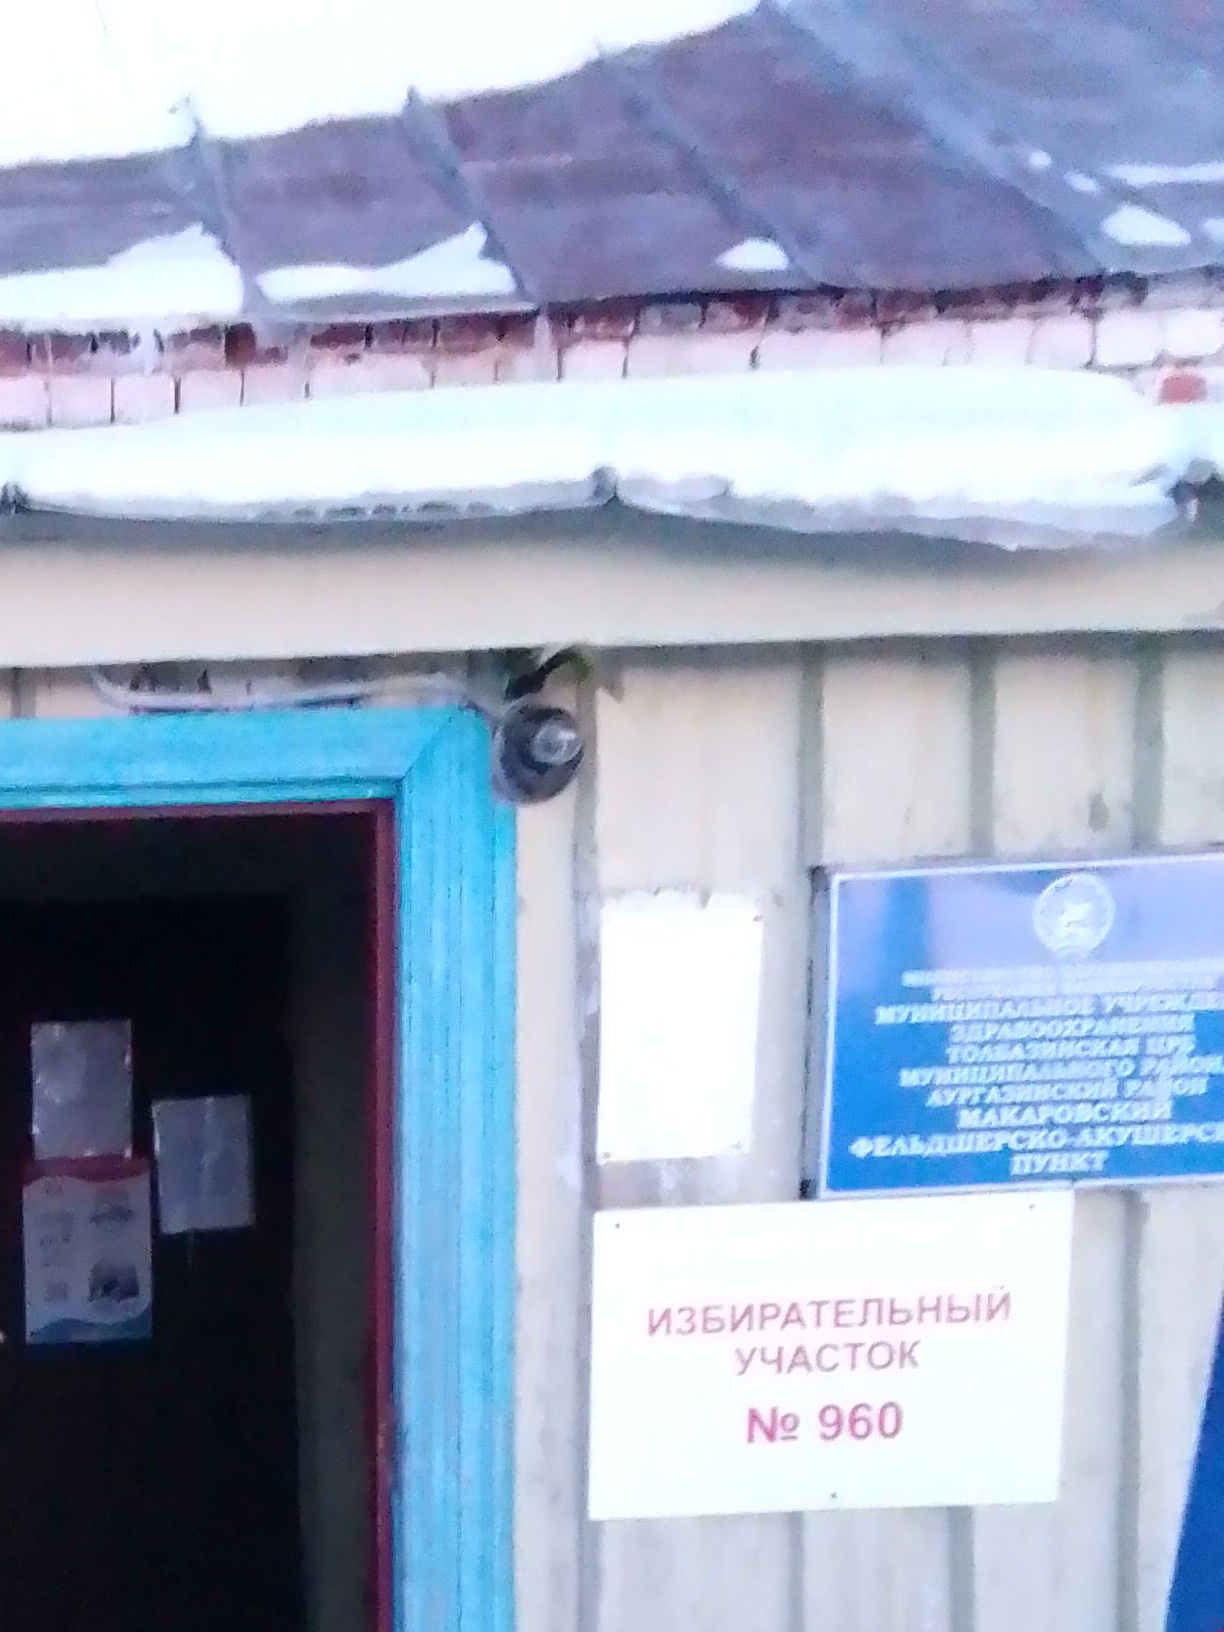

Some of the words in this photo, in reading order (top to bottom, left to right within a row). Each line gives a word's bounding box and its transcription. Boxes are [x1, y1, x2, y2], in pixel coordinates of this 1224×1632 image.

[648, 1285, 1012, 1337] ИЗБИРАТЕЛЬНЫЙ
[735, 1339, 922, 1377] УЧАСТОК
[747, 1406, 800, 1444] №
[818, 1401, 904, 1441] 960
